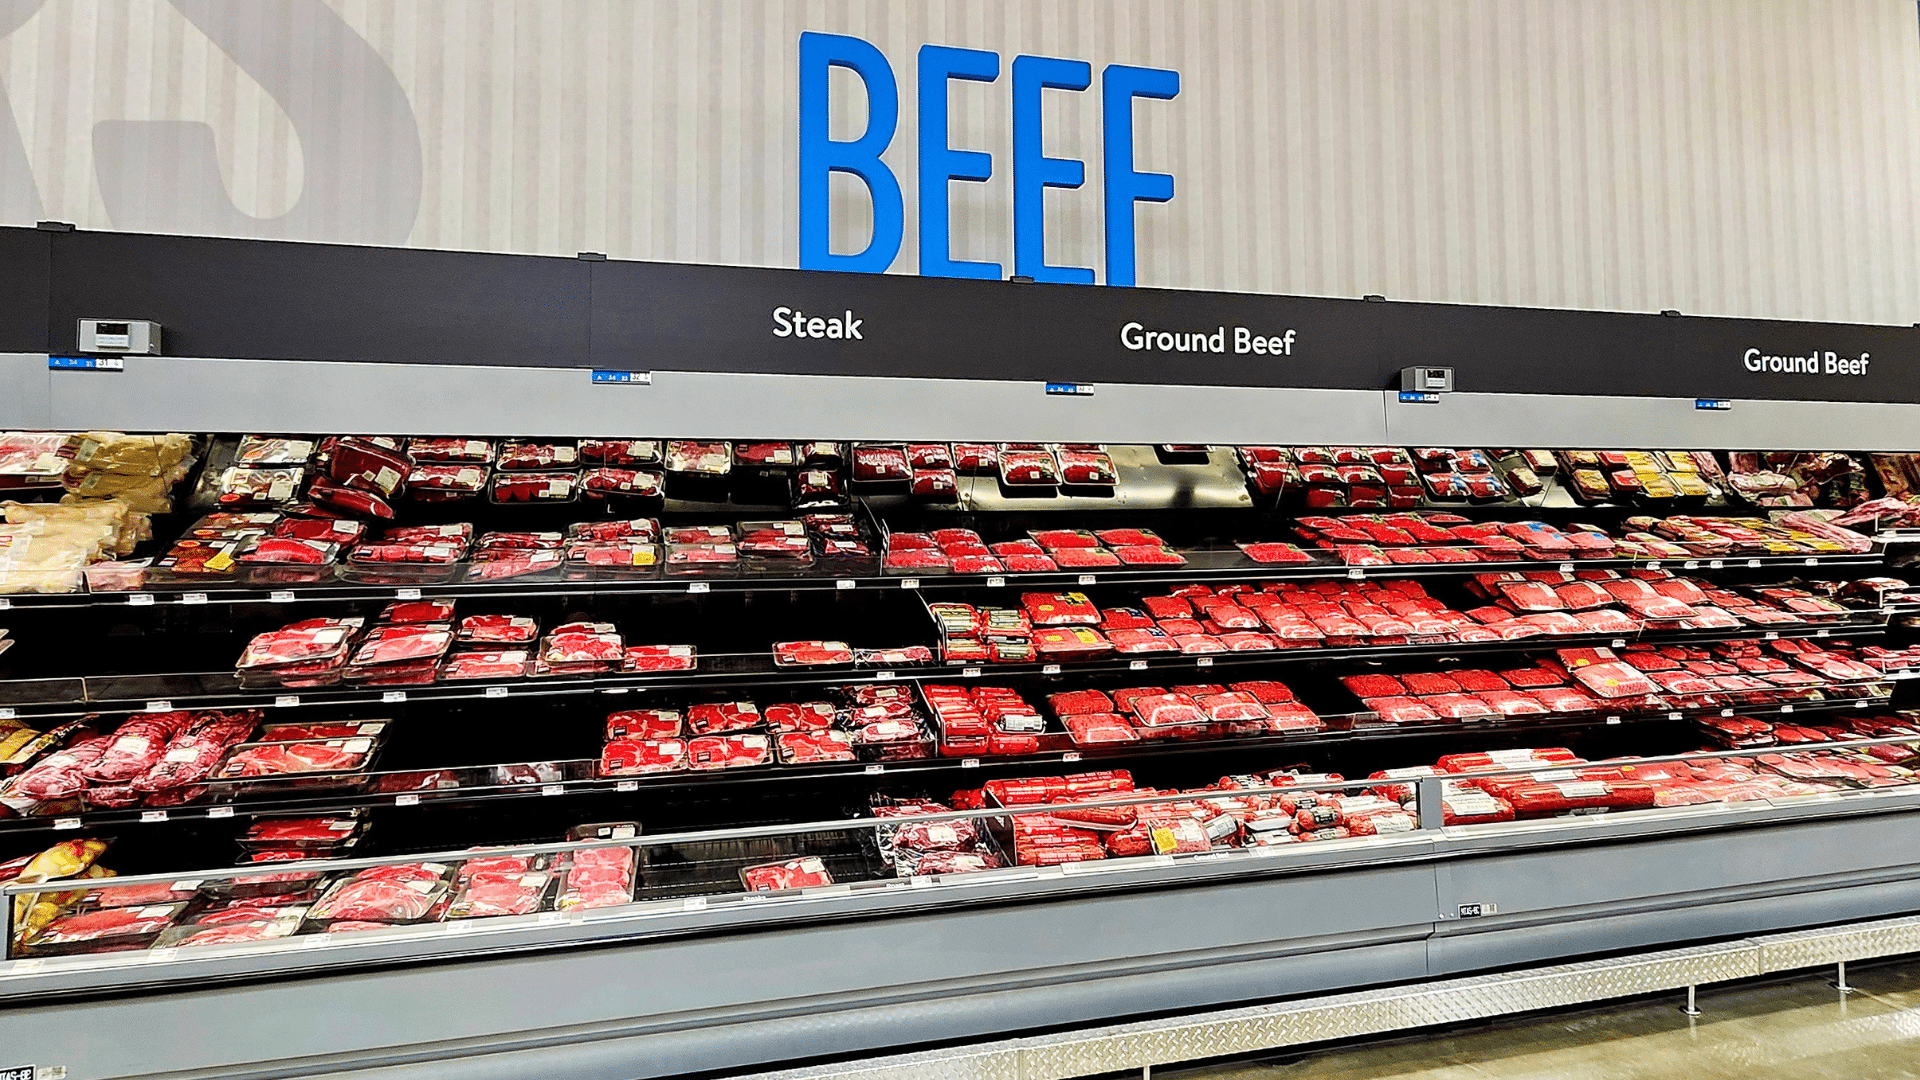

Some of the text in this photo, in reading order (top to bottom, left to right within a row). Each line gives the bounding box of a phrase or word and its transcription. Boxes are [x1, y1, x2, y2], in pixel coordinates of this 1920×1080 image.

[799, 31, 1180, 287] BEEF
[772, 306, 864, 340] Steak
[1120, 321, 1297, 356] Ground Beef
[1743, 347, 1870, 376] Ground Beef
